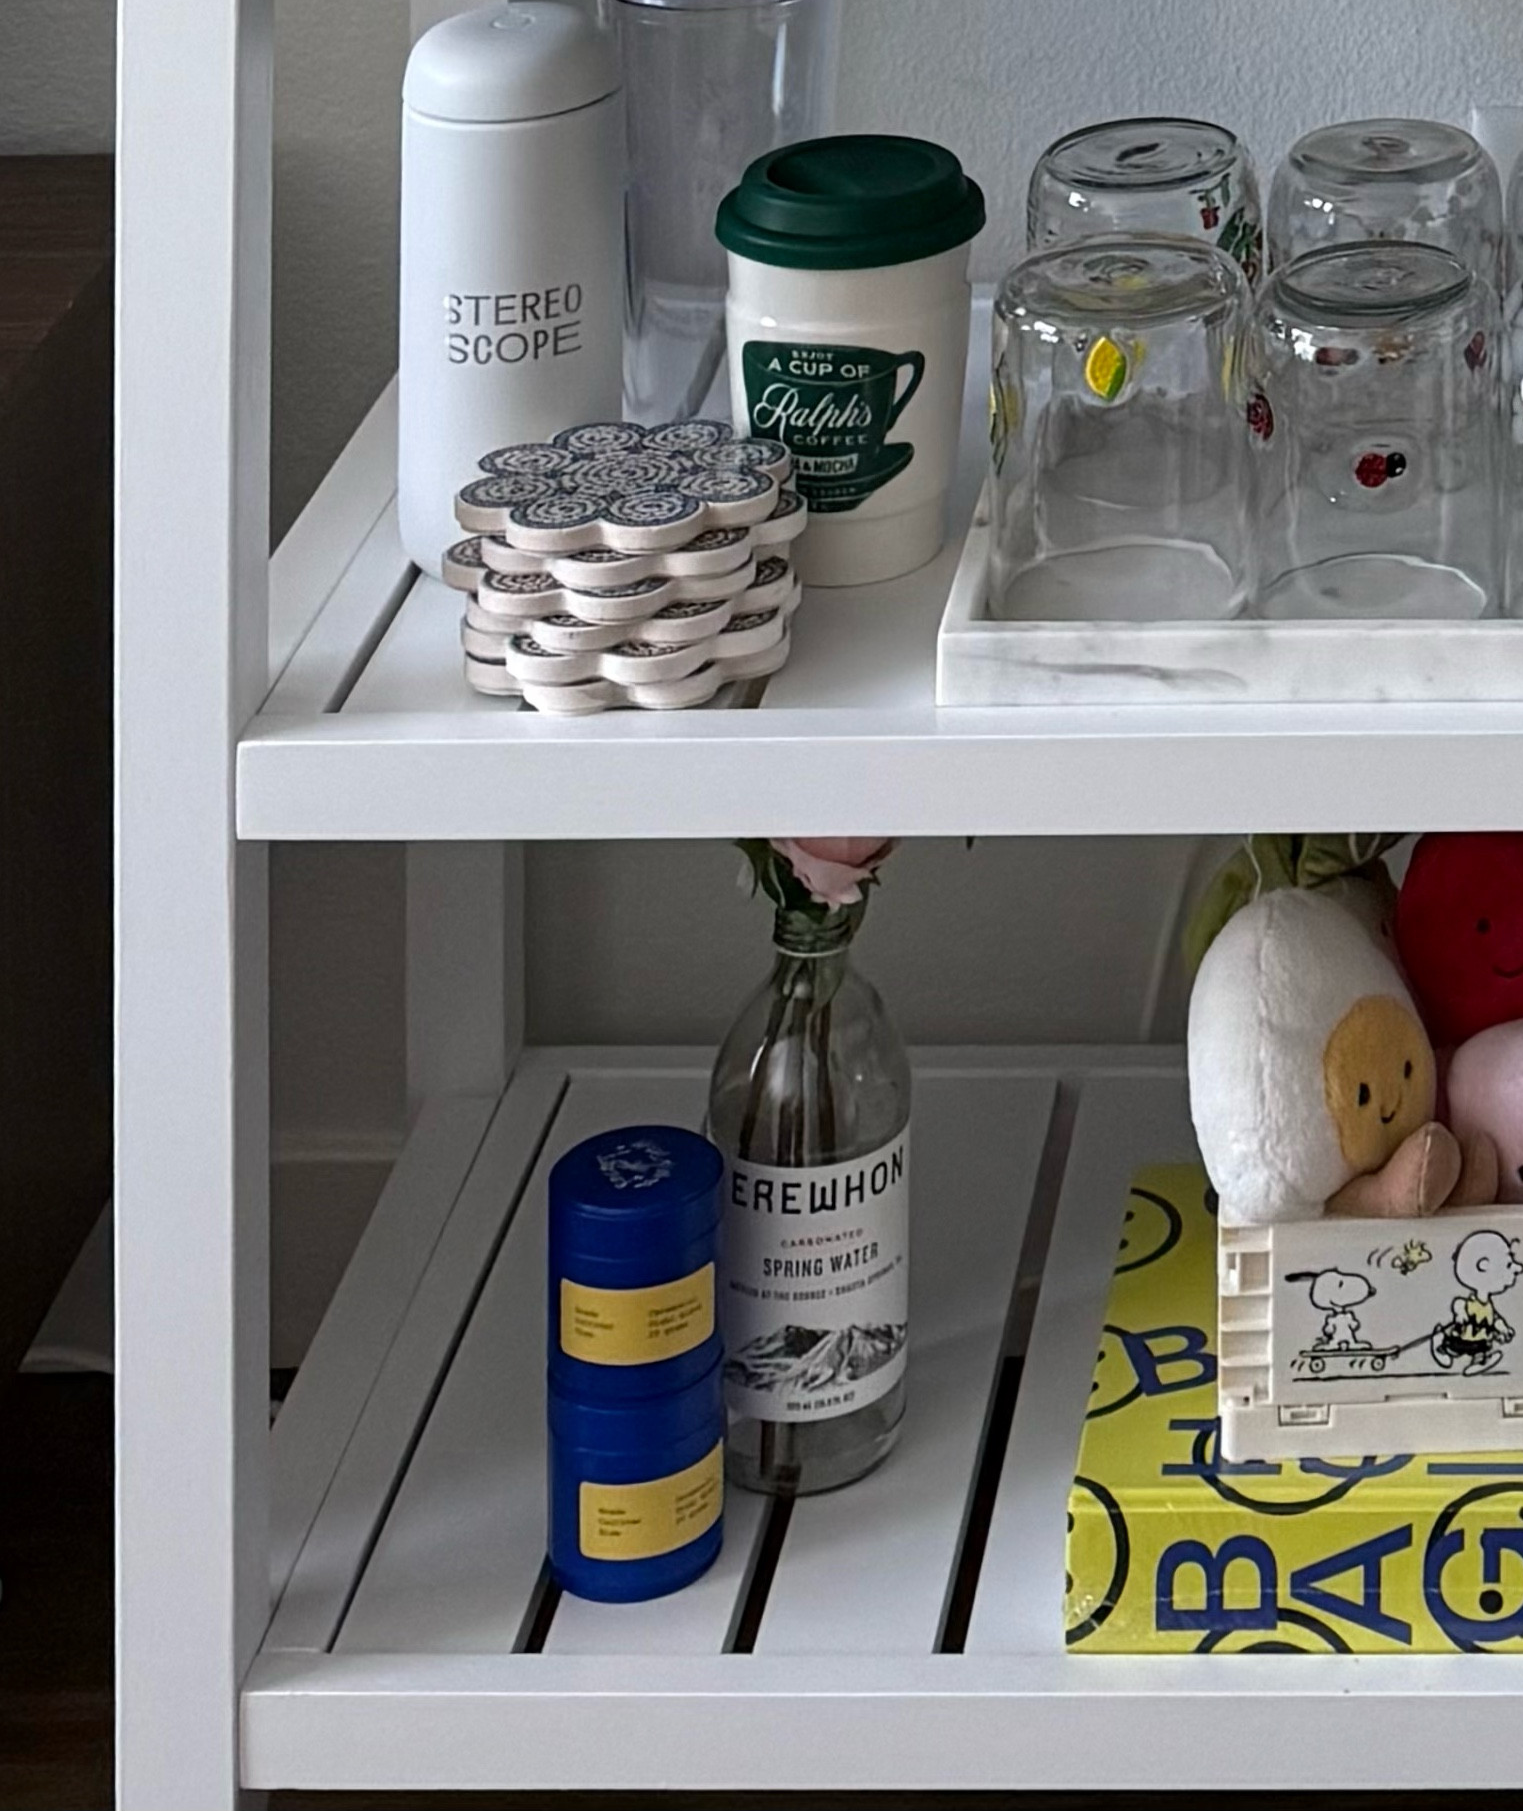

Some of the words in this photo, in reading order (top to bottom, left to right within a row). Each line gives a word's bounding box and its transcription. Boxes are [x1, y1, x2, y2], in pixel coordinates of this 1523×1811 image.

[447, 283, 582, 326] STEREO
[448, 320, 583, 365] SCOPE
[768, 357, 782, 372] A
[788, 359, 834, 376] CUP
[839, 364, 871, 378] OF
[753, 382, 873, 442] Ralph's
[792, 433, 870, 446] COFFEE
[731, 1145, 903, 1214] EREWHON
[763, 1257, 823, 1278] SPRING
[830, 1241, 879, 1273] WATER
